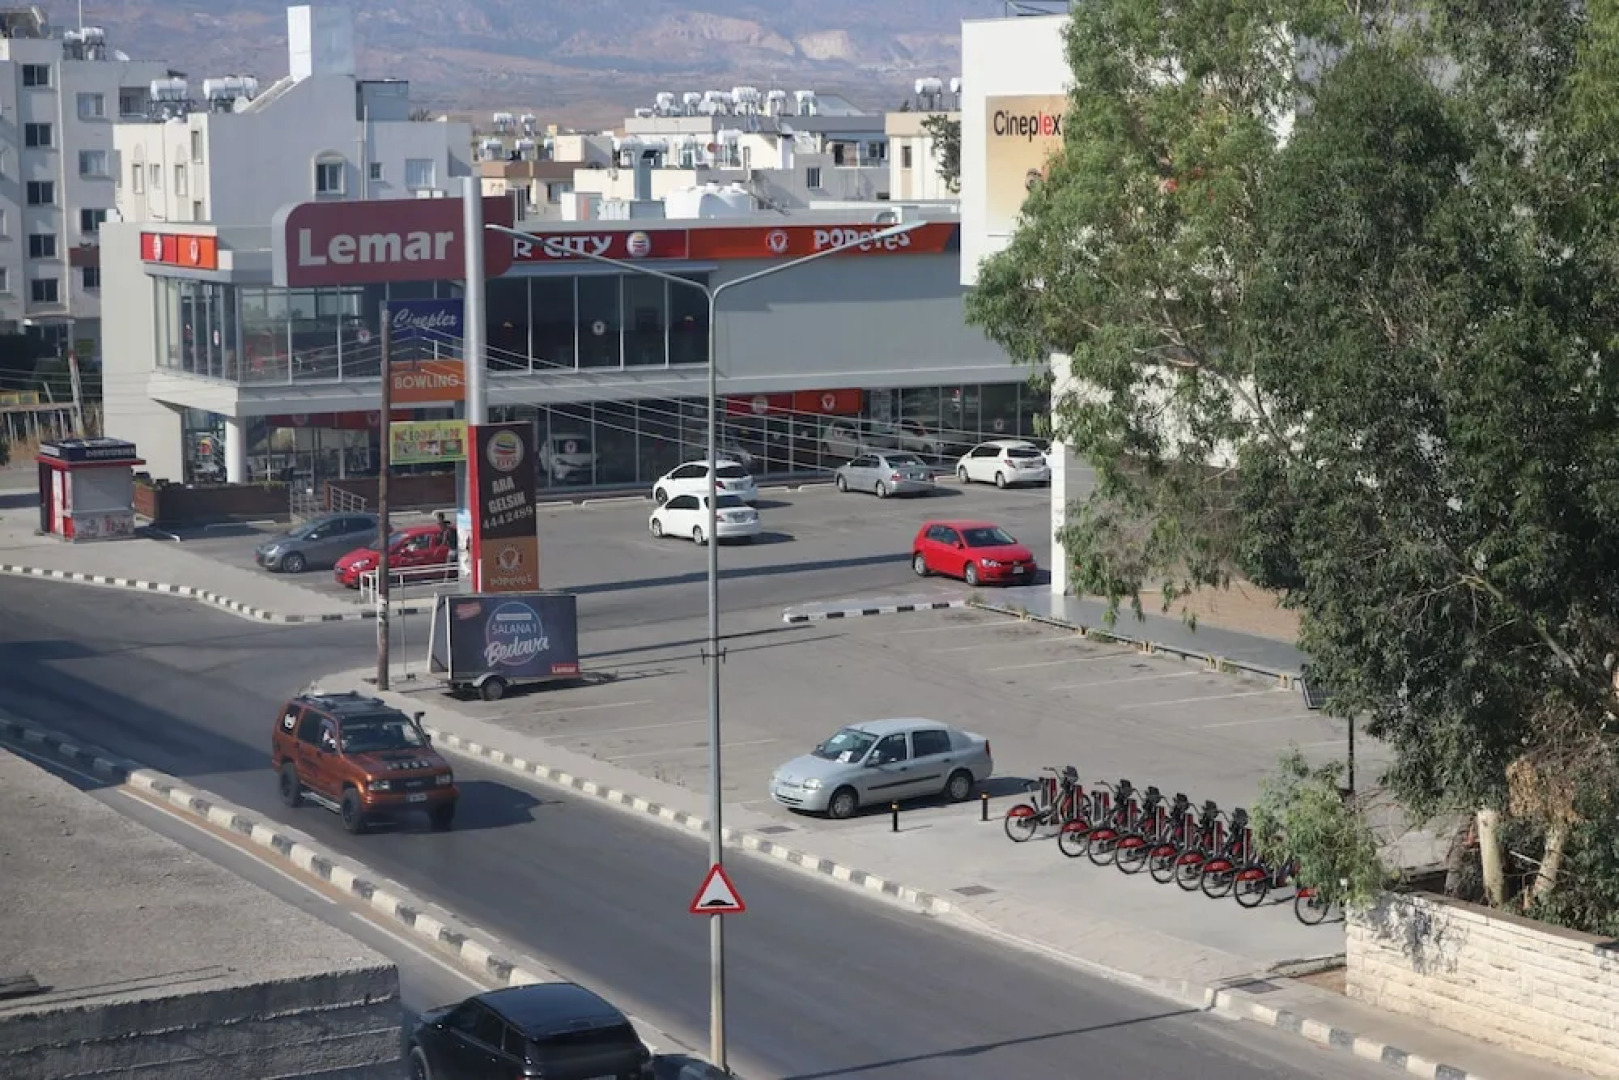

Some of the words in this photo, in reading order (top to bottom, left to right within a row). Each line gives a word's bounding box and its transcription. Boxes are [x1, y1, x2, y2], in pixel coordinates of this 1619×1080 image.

[993, 110, 1061, 142] Cineplex
[298, 228, 454, 266] Lemar
[544, 235, 612, 257] CITY
[394, 374, 459, 389] BOWLING
[491, 476, 515, 494] ARA
[491, 623, 532, 634] SALANA
[484, 636, 549, 667] Bedava
